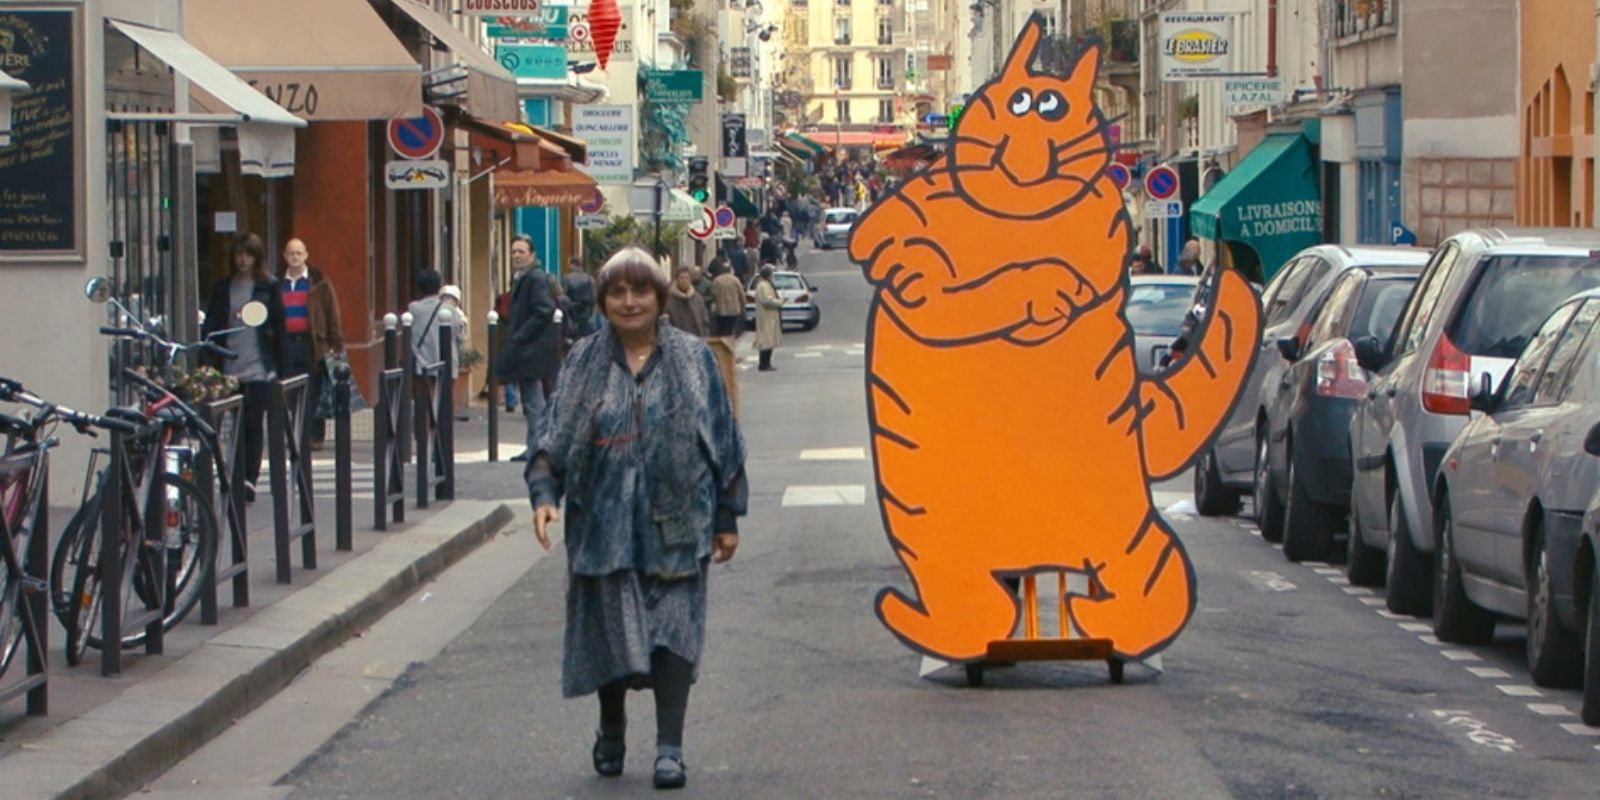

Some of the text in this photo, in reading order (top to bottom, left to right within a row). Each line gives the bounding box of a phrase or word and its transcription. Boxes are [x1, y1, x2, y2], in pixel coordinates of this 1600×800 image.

[467, 0, 536, 10] COUSCOUS
[1164, 15, 1225, 23] RESTAURANT
[1163, 38, 1228, 56] LE BRASIER
[1225, 82, 1281, 92] EPICERIE
[248, 80, 318, 116] NZO
[1231, 93, 1274, 103] LAZAL
[582, 109, 622, 118] DROGUERIE
[575, 124, 629, 133] QUINCAILLERIE
[1241, 224, 1251, 237] A
[1392, 226, 1403, 243] P
